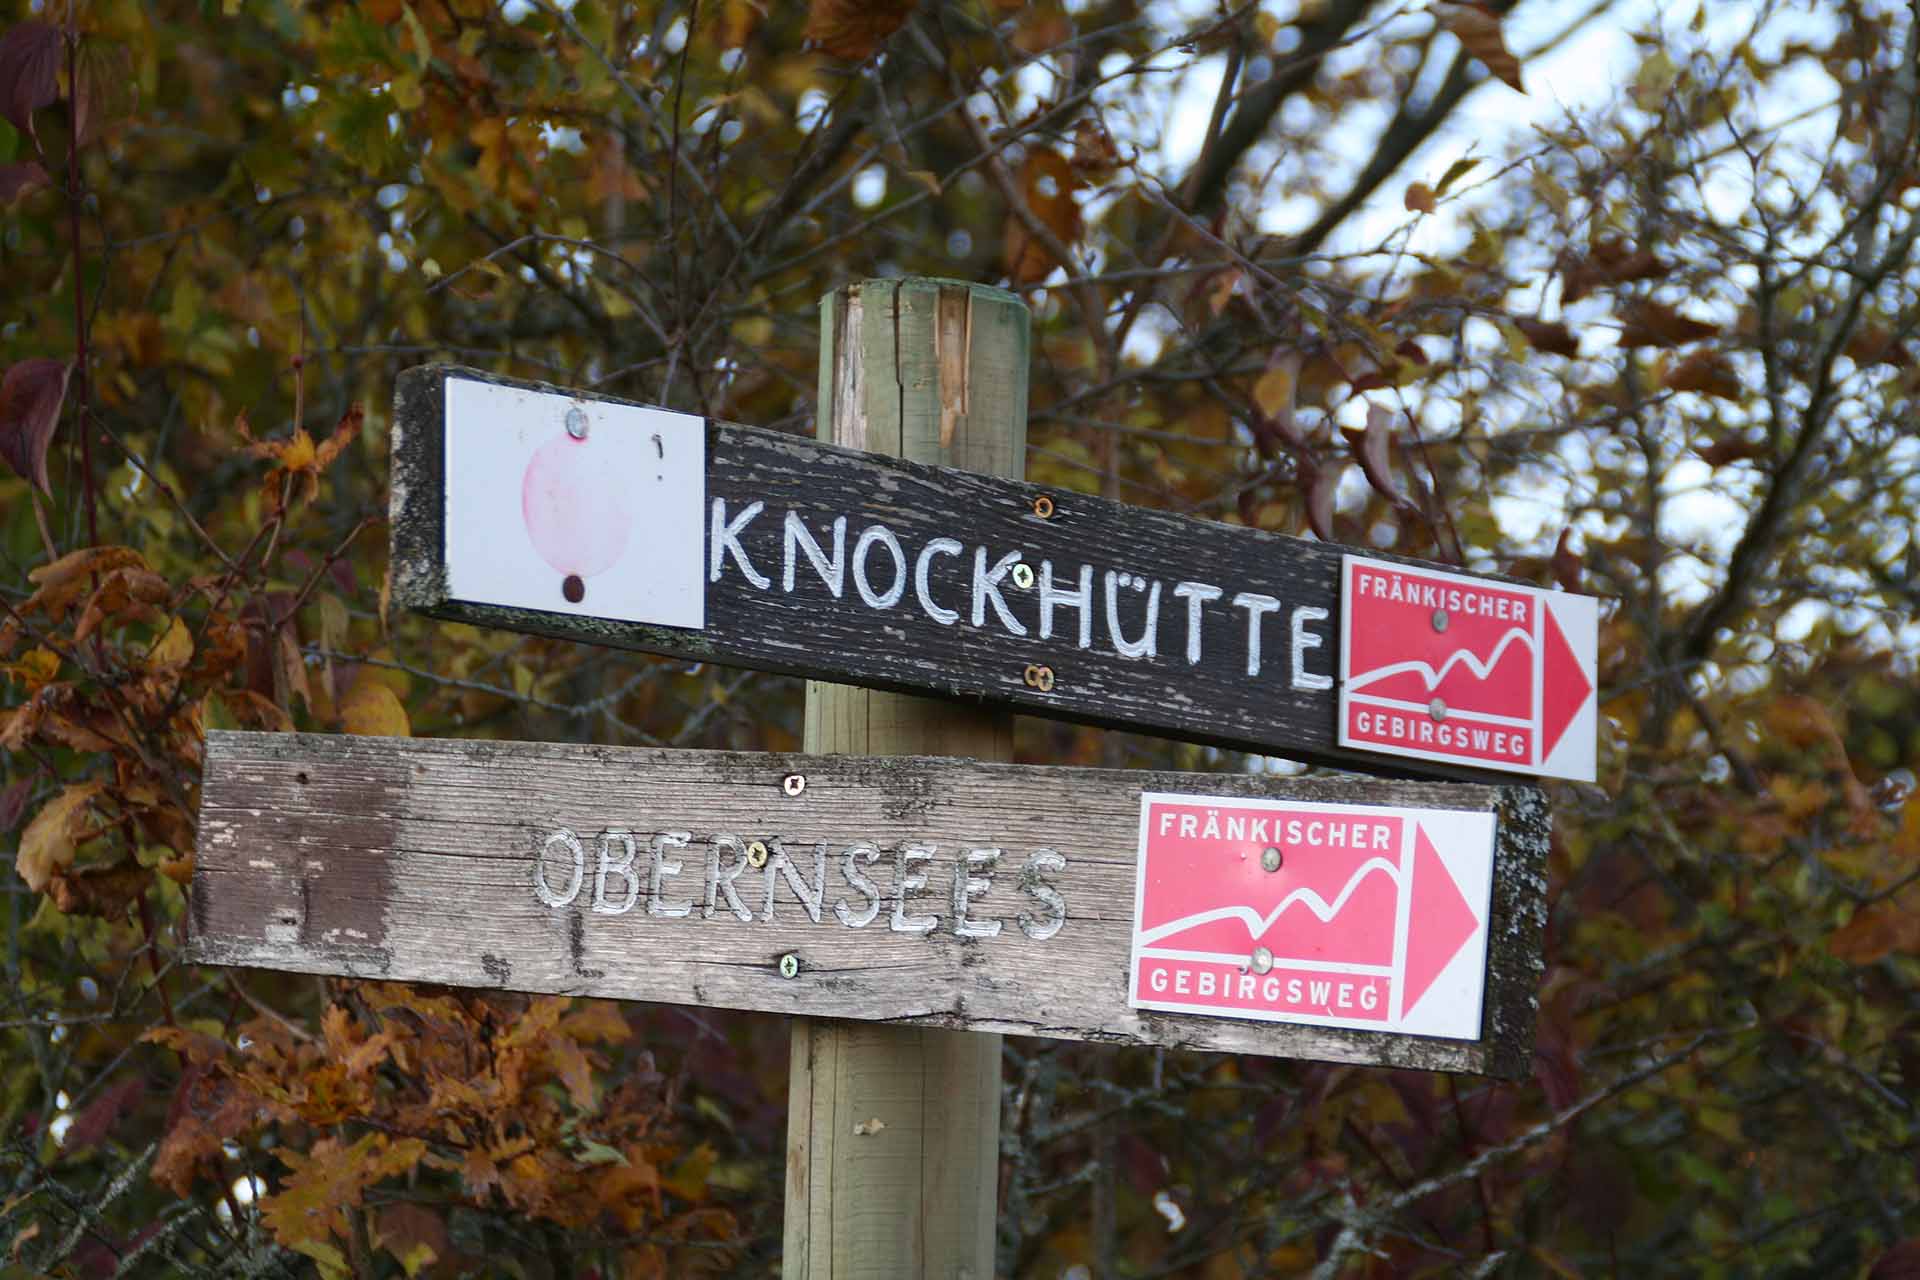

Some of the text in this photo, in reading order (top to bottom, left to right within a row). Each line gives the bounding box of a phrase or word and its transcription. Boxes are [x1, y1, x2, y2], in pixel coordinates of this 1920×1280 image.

[710, 497, 1334, 690] KNOCKHÜTTE
[1359, 574, 1527, 622] FRÄNKISCHER
[1356, 711, 1526, 756] GEBIRGSWEG
[1159, 810, 1391, 850] FRÄNKISCHER
[535, 826, 1068, 940] OBERNSEES
[1150, 968, 1378, 1011] GEBIRGSWEG
